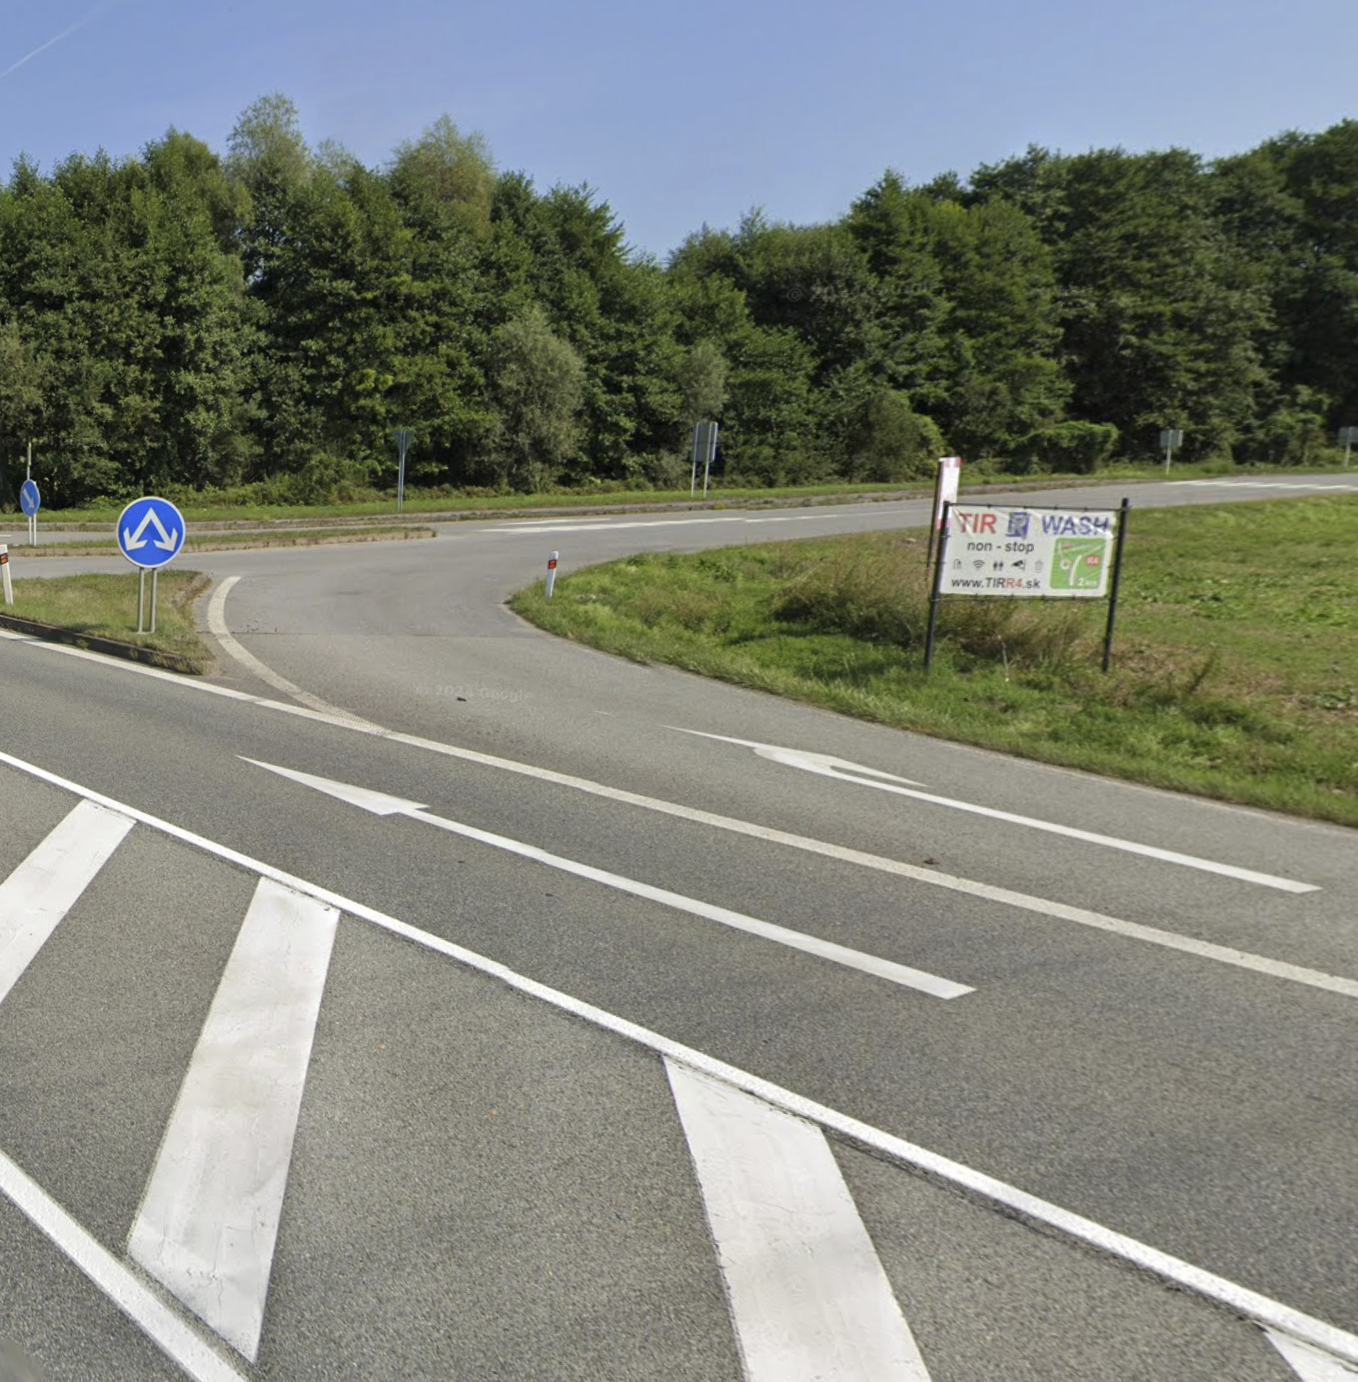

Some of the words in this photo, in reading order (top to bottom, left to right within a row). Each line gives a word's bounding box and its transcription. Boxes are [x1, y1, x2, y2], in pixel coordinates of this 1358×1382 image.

[958, 512, 998, 534] TIR
[1042, 514, 1111, 536] WASH
[967, 541, 992, 552] non
[1005, 540, 1035, 555] stop
[951, 576, 1041, 589] www.TIRR4.sk
